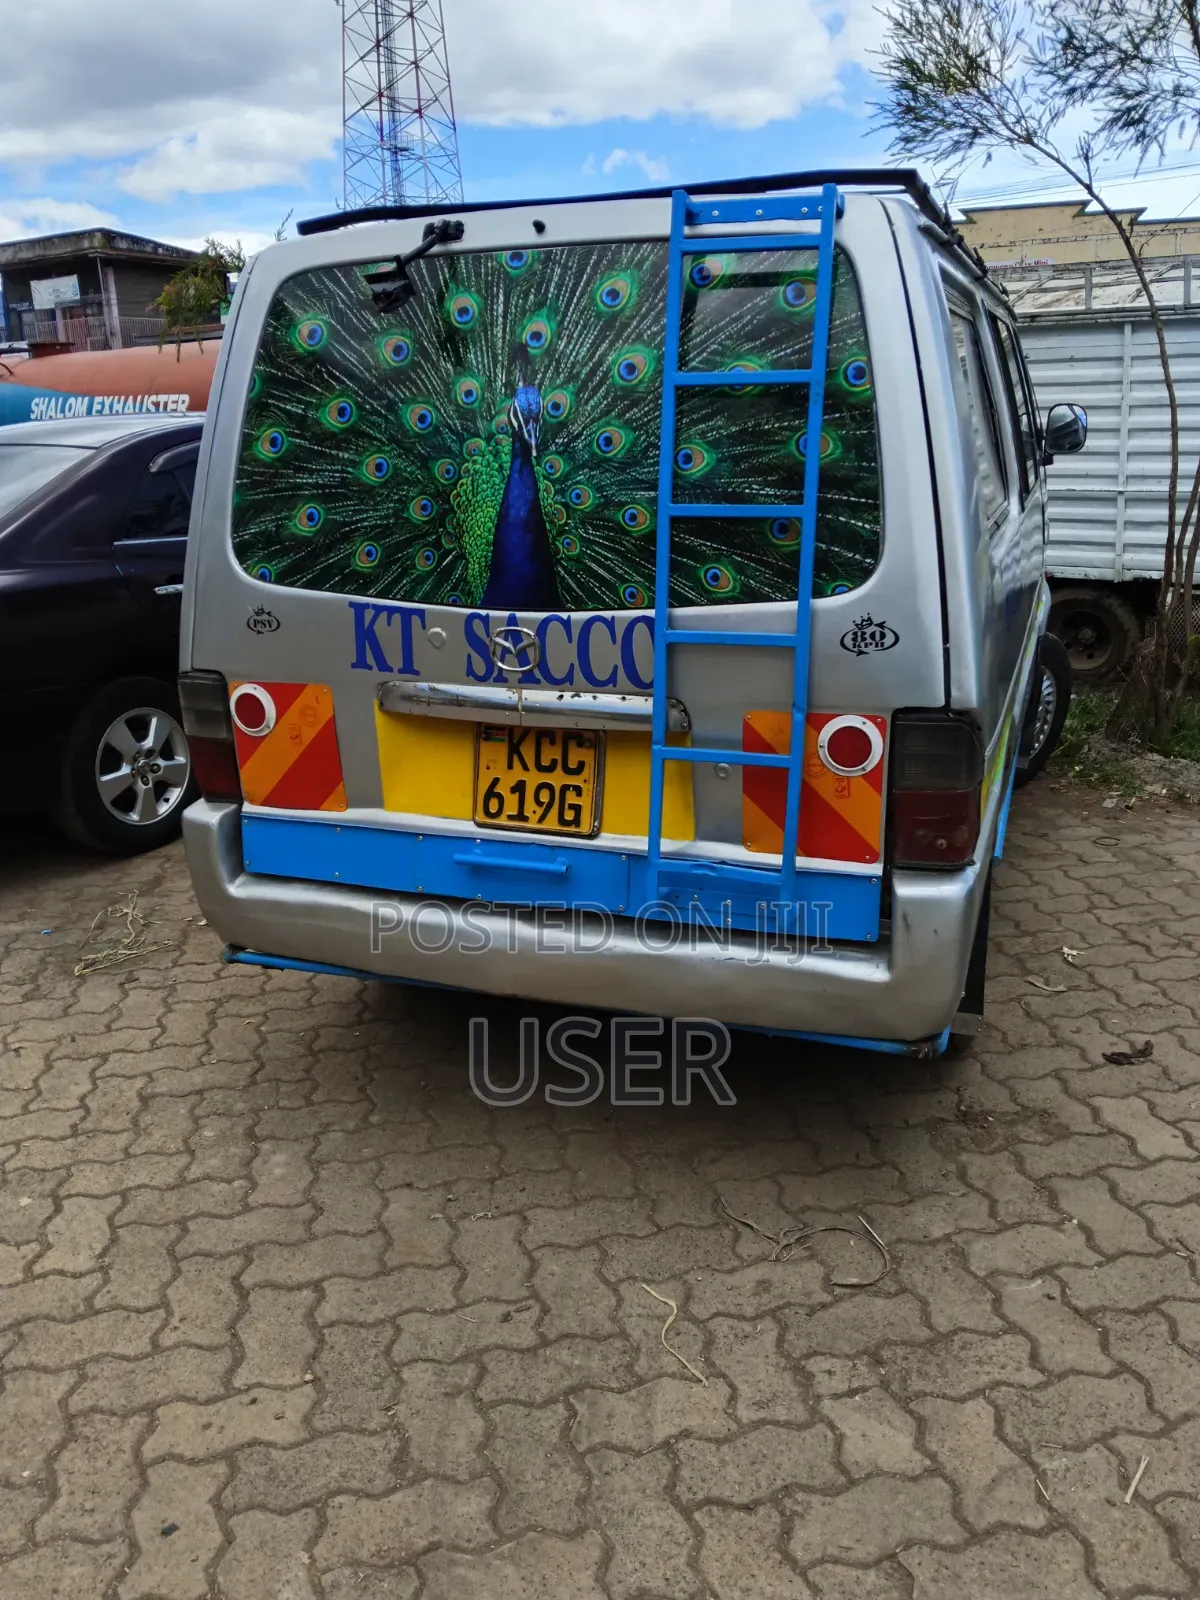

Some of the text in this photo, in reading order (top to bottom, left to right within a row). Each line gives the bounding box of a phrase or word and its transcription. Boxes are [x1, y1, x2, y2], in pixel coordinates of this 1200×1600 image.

[30, 394, 190, 420] SHALOM EXHAUSTER
[253, 618, 274, 629] PSV
[851, 630, 887, 642] 80
[348, 601, 655, 690] KT SACCO
[852, 641, 885, 649] KPH
[507, 726, 586, 776] KCC
[482, 776, 583, 828] 619G
